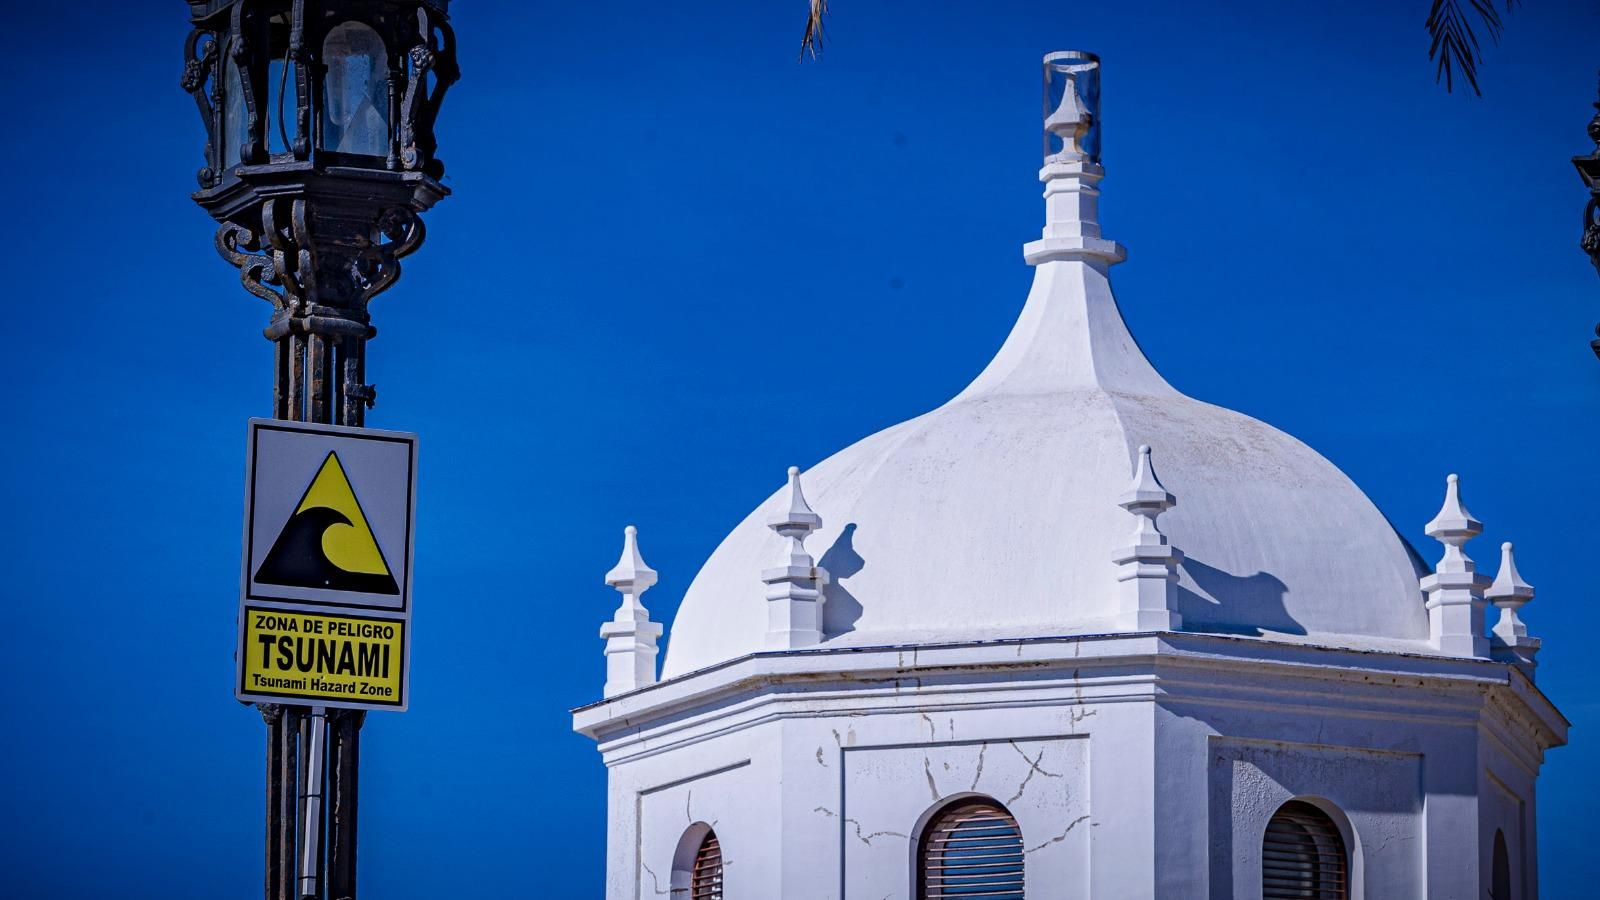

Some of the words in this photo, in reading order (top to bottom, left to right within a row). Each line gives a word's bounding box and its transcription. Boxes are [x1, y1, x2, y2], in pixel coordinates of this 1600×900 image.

[255, 615, 298, 632] ZONA
[303, 619, 323, 634] DE
[328, 621, 394, 640] PELIGRO
[258, 634, 390, 678] TSUNAMI
[252, 673, 306, 690] Tsunami
[310, 678, 356, 694] Hazard
[359, 682, 393, 696] Zone
